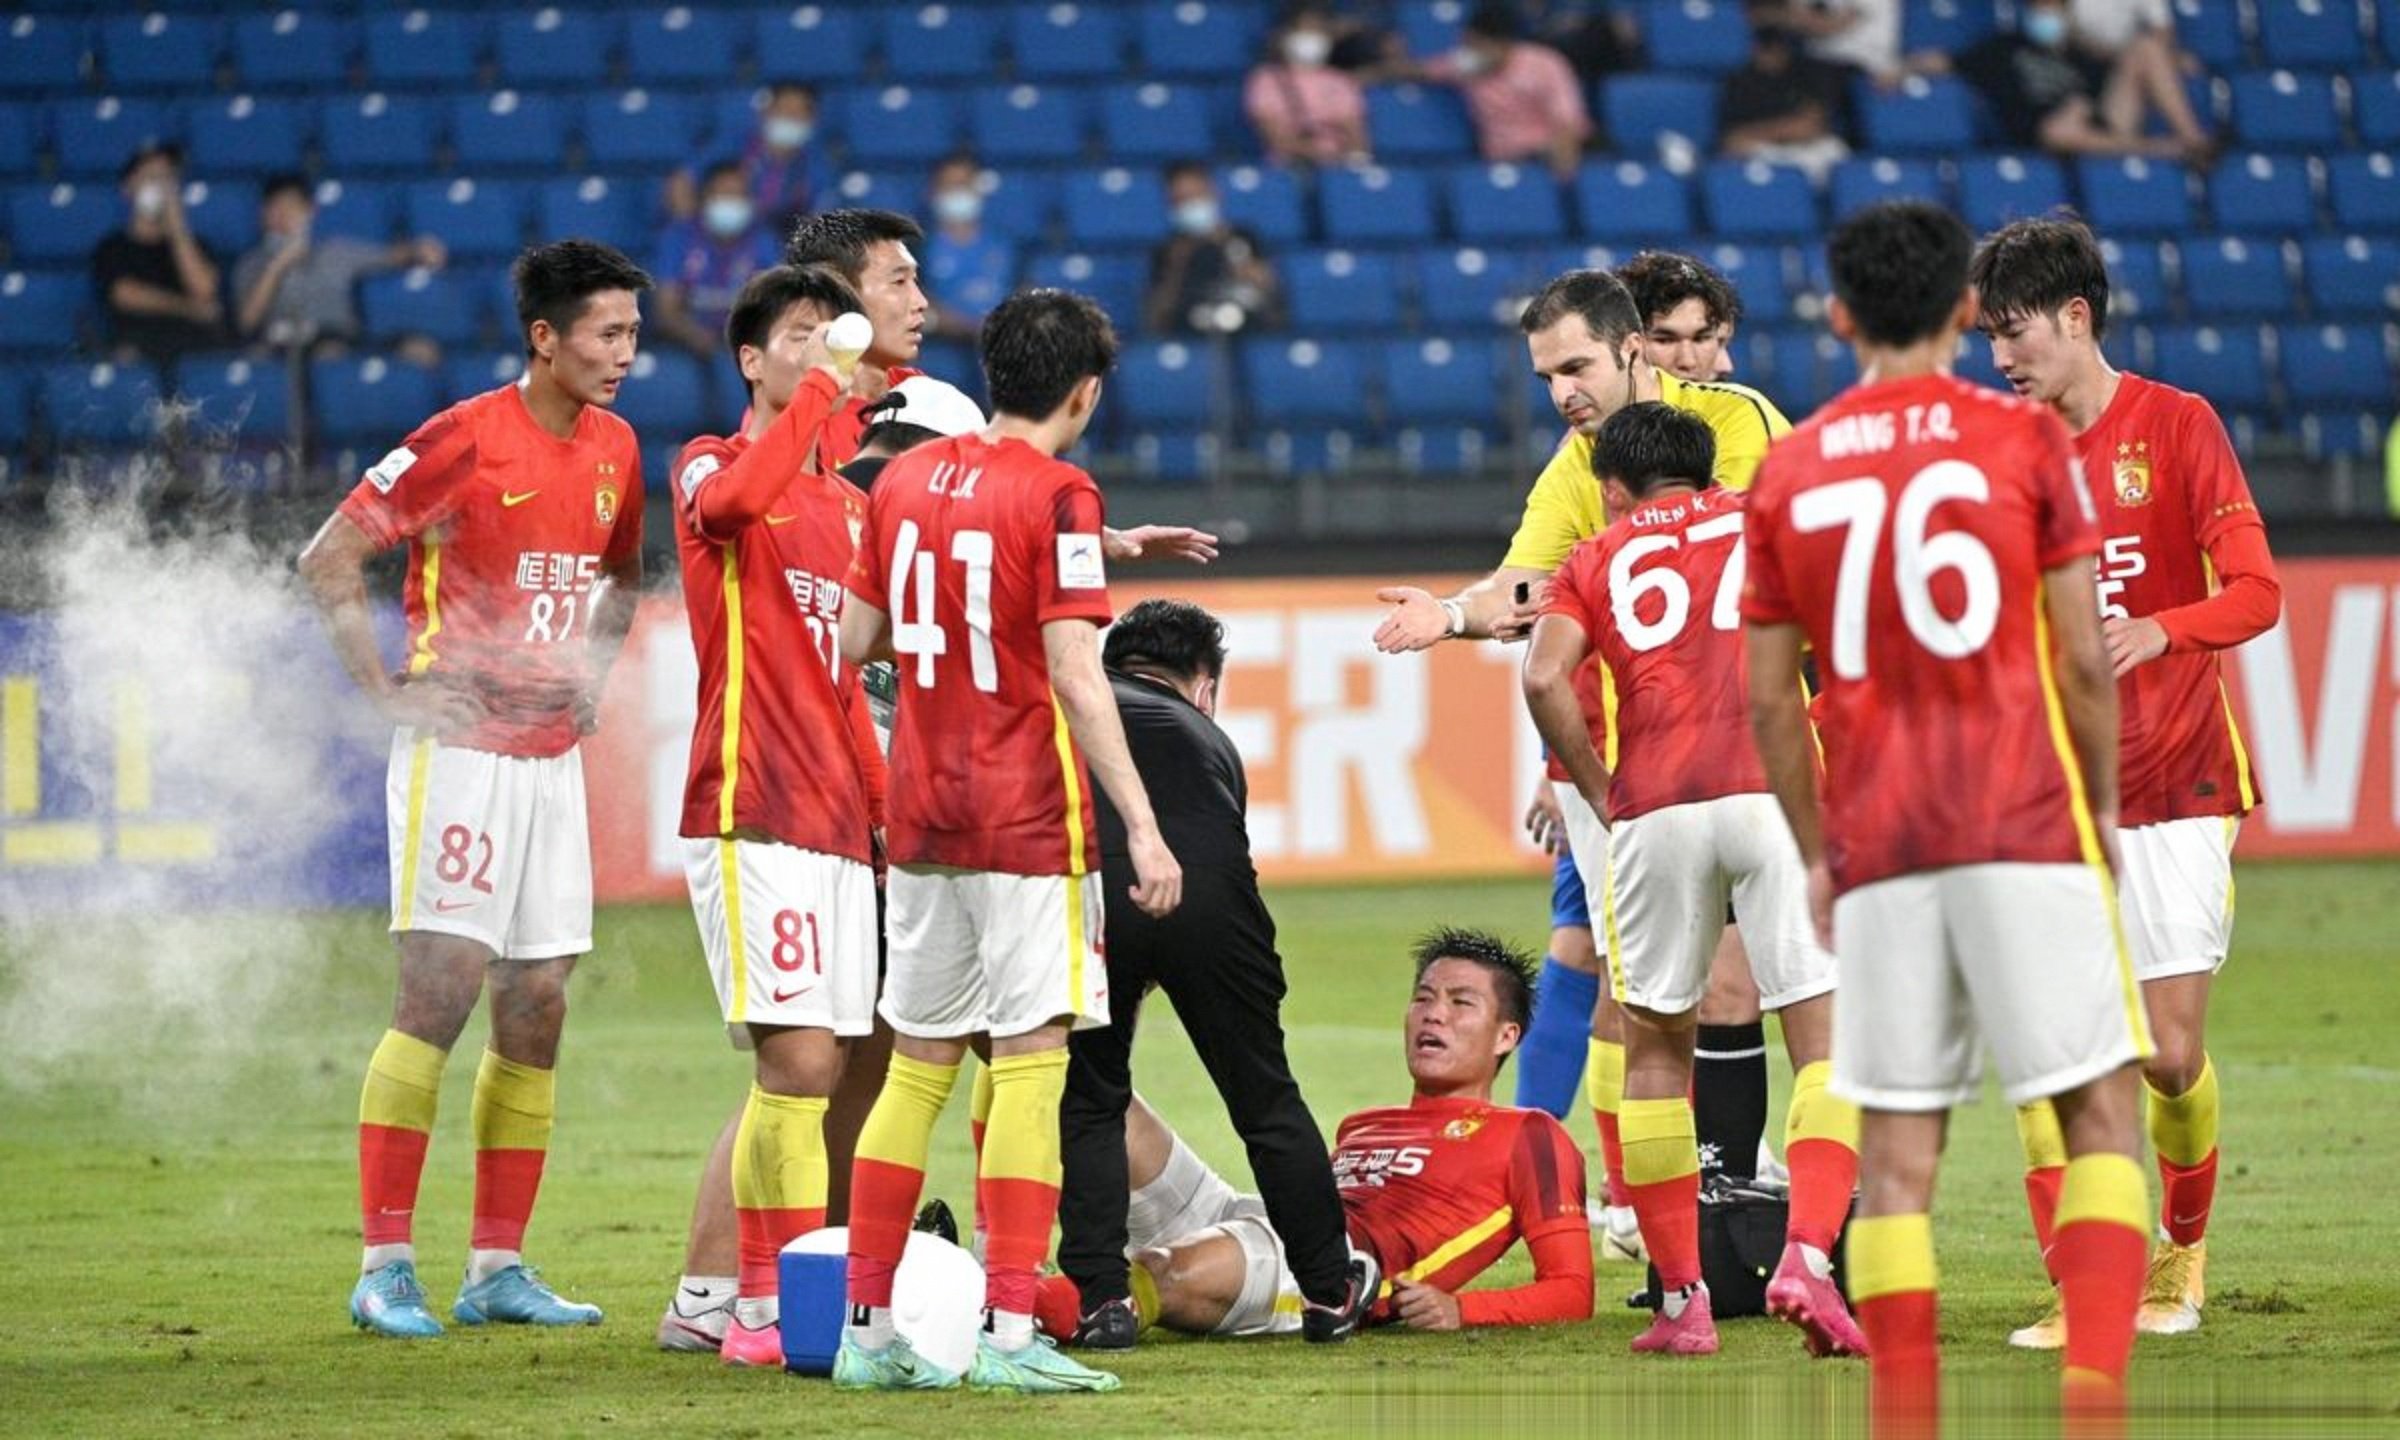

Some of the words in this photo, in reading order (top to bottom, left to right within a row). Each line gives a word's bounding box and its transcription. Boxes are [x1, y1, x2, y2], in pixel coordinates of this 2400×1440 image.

[1631, 504, 1686, 527] CHEN
[888, 518, 998, 693] 41
[1608, 511, 1747, 652] 67
[1789, 458, 2002, 682] 76
[435, 823, 494, 895] 82
[771, 908, 821, 975] 81
